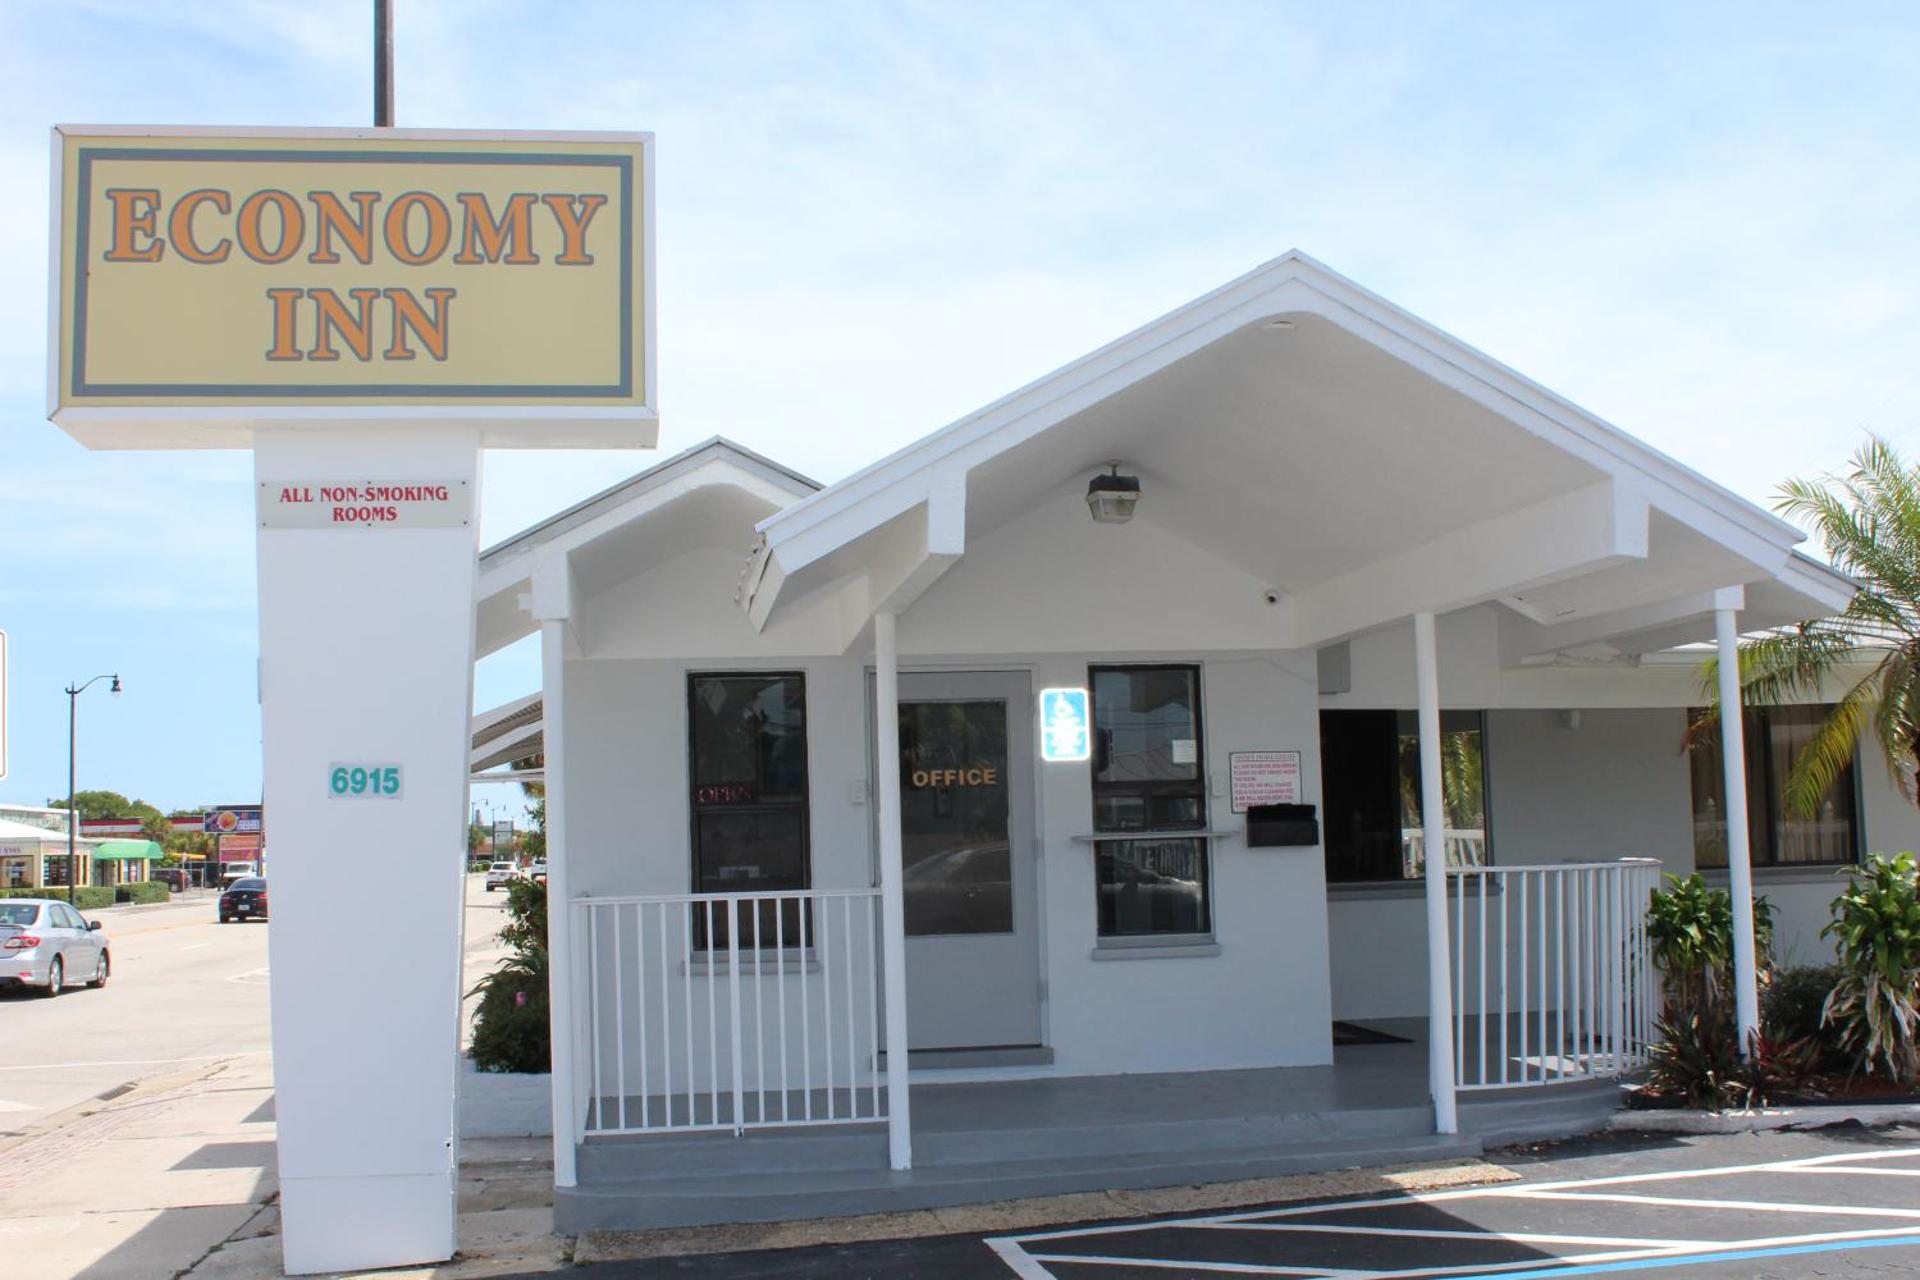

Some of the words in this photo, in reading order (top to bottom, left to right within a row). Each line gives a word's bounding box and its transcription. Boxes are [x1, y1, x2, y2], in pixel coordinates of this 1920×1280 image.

[104, 188, 608, 265] ECONOMY
[265, 288, 456, 361] INN
[280, 488, 313, 502] ALL
[320, 486, 448, 502] NON-SMOKING
[332, 507, 397, 521] ROOMS
[332, 768, 400, 794] 6915
[912, 769, 998, 787] OFFICE
